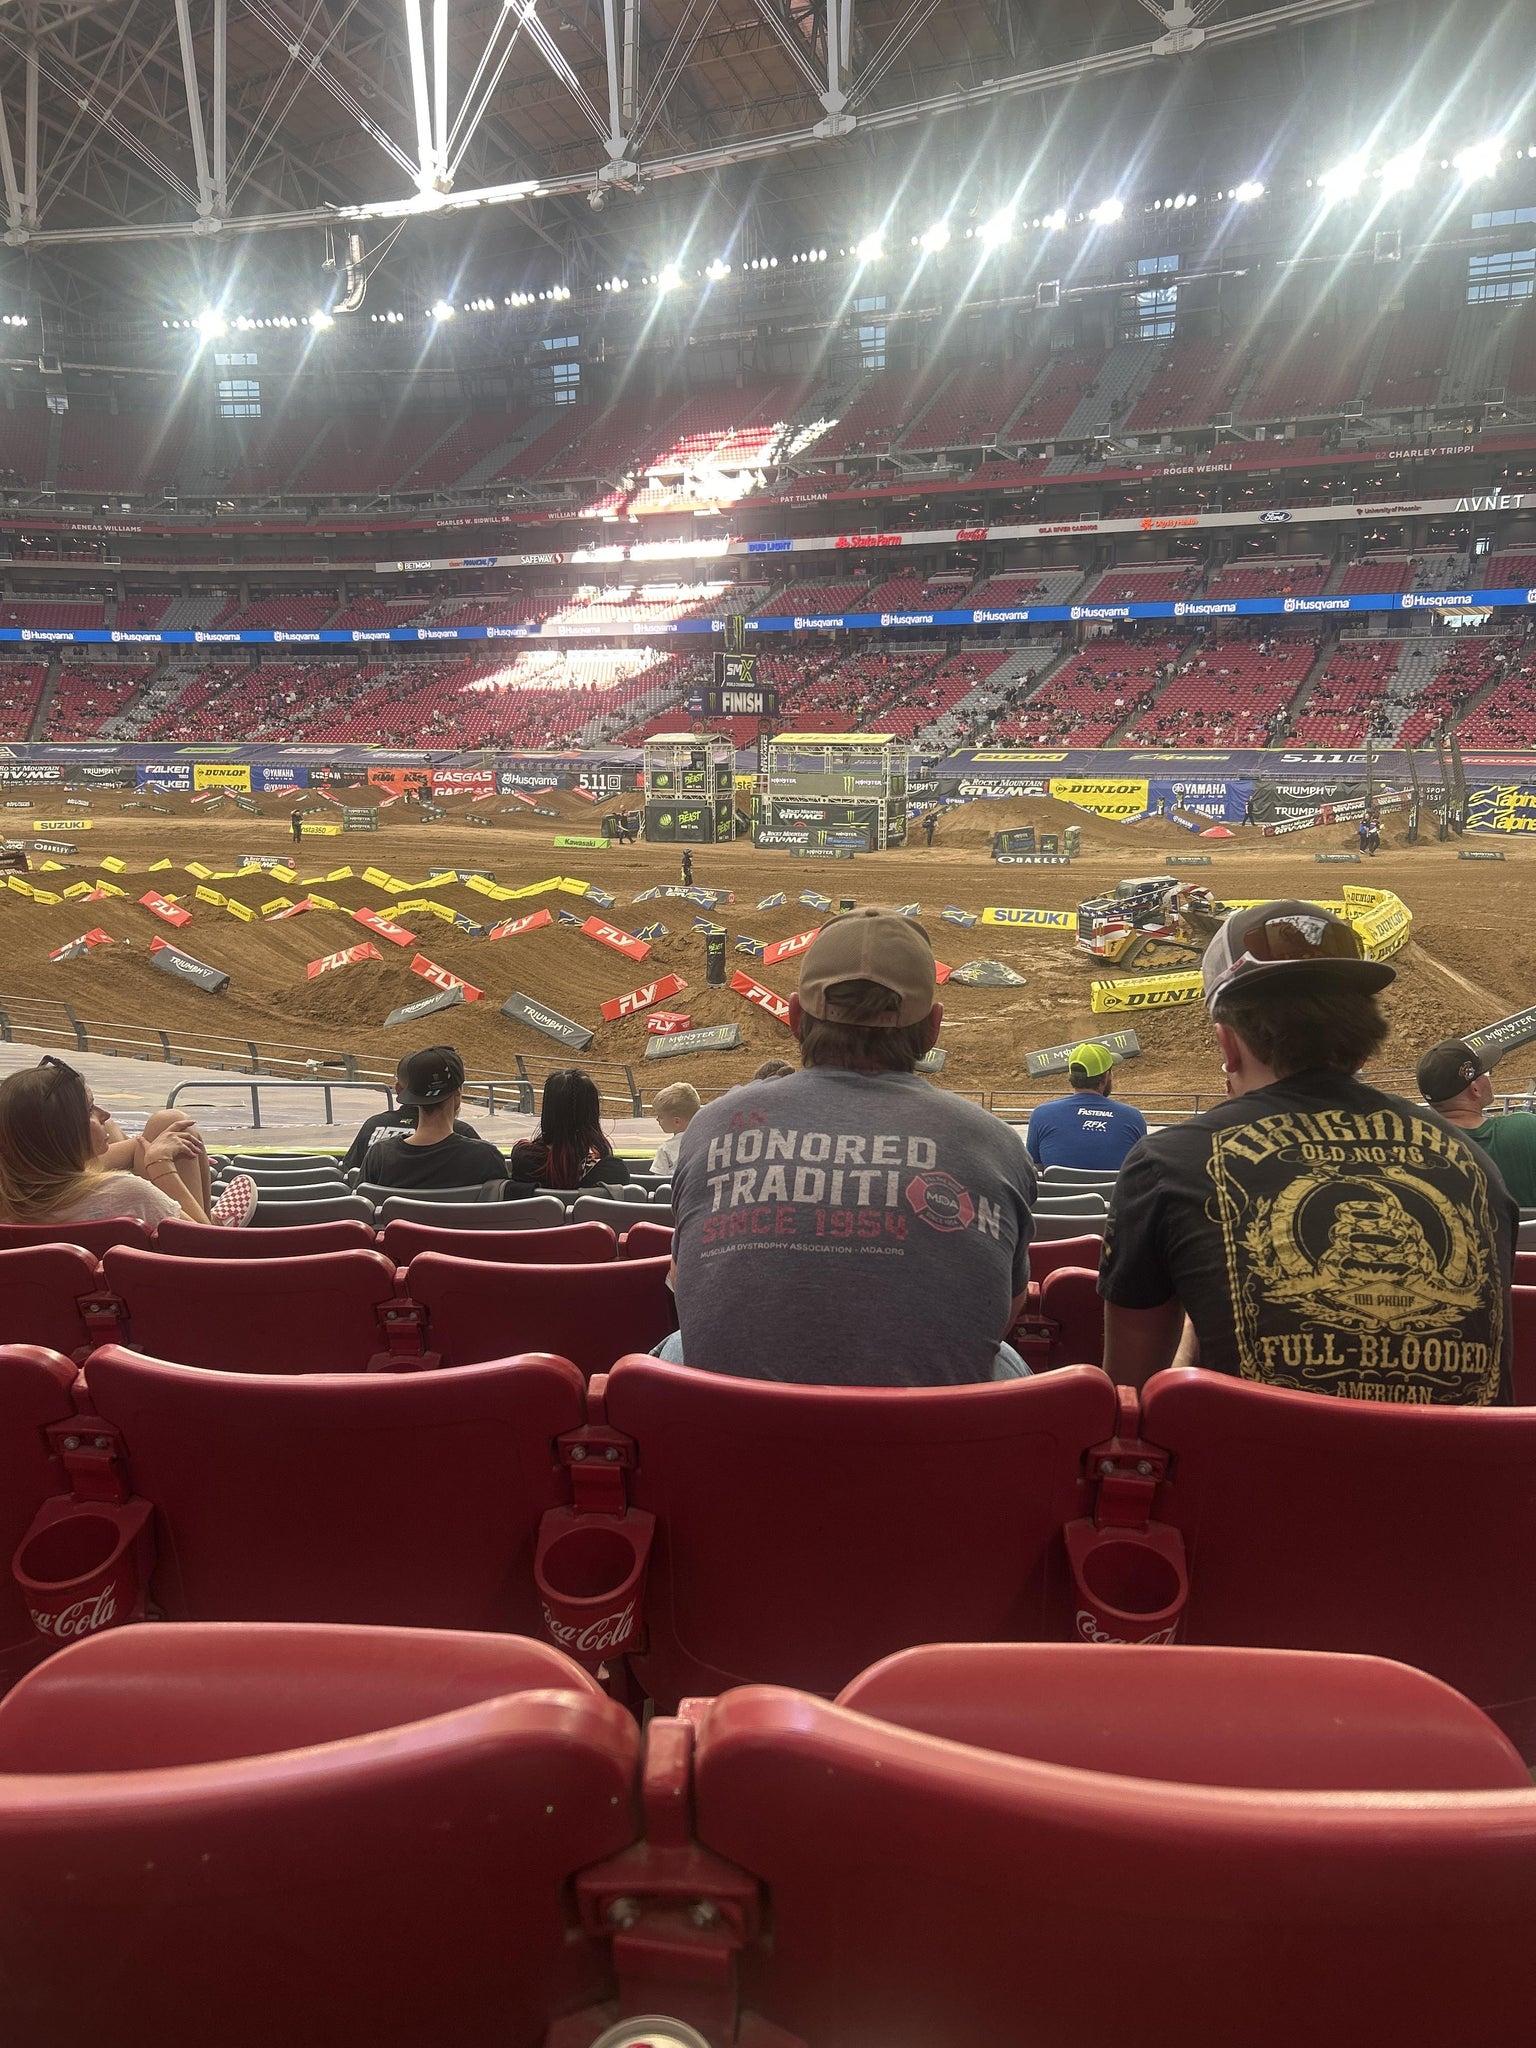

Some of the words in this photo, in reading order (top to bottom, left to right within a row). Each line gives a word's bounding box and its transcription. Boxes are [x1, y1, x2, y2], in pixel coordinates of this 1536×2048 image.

[1388, 448, 1438, 459] CHARLEY
[1440, 445, 1474, 456] TRIPPI
[1163, 467, 1194, 476] ROGER
[1196, 463, 1232, 474] WEHRLI
[780, 496, 794, 504] PAT
[796, 493, 828, 503] TILLMAN
[1455, 494, 1524, 512] AVNET
[437, 518, 462, 527] CHARLES
[1264, 511, 1287, 522] Ford
[71, 523, 102, 532] AENEAS
[104, 525, 142, 533] WILLIAMS
[956, 528, 989, 541] Coca-Cola
[749, 543, 764, 553] BUD
[766, 540, 792, 551] LIGHT
[404, 561, 431, 570] BETMGM
[520, 554, 553, 565] SAFEWAY
[1295, 597, 1350, 611] Husqvarna
[1414, 593, 1472, 607] Husqvarna
[1081, 607, 1129, 619] Husqvarna
[1185, 601, 1236, 615] Husqvarna
[890, 614, 933, 625] Husqvarna
[983, 610, 1029, 622] Husqvarna
[803, 617, 844, 628] Husqvarna
[31, 631, 74, 641] Husqvarna
[120, 632, 162, 642] Husqvarna
[203, 632, 241, 642] Husqvarna
[282, 631, 320, 641] Husqvarna
[359, 631, 391, 641] Husqvarna
[425, 630, 458, 639] Husqvarna
[494, 627, 527, 637] Husqvarna
[722, 692, 763, 713] FINISH
[976, 753, 1066, 761] SUZUKI
[1280, 753, 1343, 763] 5.11
[22, 765, 59, 773] MOUNTAIN
[83, 767, 113, 776] TRIUMPH
[145, 765, 190, 775] FALKEN
[205, 769, 246, 778] DUNLOP
[270, 768, 294, 778] YAMAHA
[372, 772, 395, 782] KTM
[433, 770, 493, 782] GASGAS
[511, 774, 558, 786] Husqvarna
[579, 774, 607, 789] 5.11
[972, 778, 999, 786] ROCKY
[1000, 779, 1043, 787] MOUNTAIN
[1070, 784, 1142, 794] DUNLOP
[1184, 783, 1226, 795] YAMAHA
[1275, 786, 1325, 797] TRIUMPH
[678, 810, 702, 825] BEAST
[40, 822, 85, 830] SUZUKI
[564, 839, 596, 847] Kawasaki
[1351, 893, 1376, 904] DUNLOP
[150, 899, 180, 918] FLY
[993, 909, 1069, 926] SUZUKI
[1376, 910, 1404, 937] DUNLOP
[367, 916, 403, 935] FLY
[502, 917, 533, 936] FLY
[596, 926, 635, 948] FLY
[777, 932, 813, 955] FLY
[170, 955, 205, 976] TRIUMPH
[320, 949, 353, 974] FLY
[424, 963, 464, 989] FLY
[619, 985, 657, 1015] FLY
[746, 985, 790, 1016] FLY
[401, 997, 434, 1016] TRIUMPH
[523, 1005, 564, 1033] TRIUMPH
[648, 1019, 676, 1032] FLY
[1485, 1015, 1536, 1041] MONSTER
[668, 1031, 715, 1043] MONSTER
[1077, 1107, 1114, 1118] FASTENAL
[728, 1109, 768, 1129] AN
[1083, 1120, 1108, 1129] RFK
[1221, 1109, 1477, 1178] ORIGINAL
[706, 1128, 938, 1173] HONORED
[1301, 1143, 1346, 1163] OLD
[926, 1191, 960, 1210] MDA
[700, 1206, 798, 1244] SINCE
[815, 1207, 910, 1241] 1954
[700, 1244, 736, 1259] MUSCULAR
[737, 1243, 788, 1254] DYSTROPHY
[789, 1243, 853, 1254] ASSOCIATION
[859, 1245, 905, 1256] MDA.ORG
[1354, 1294, 1375, 1305] 100
[1377, 1294, 1416, 1308] PROOF
[1260, 1333, 1489, 1374] FULL-BLOODED
[1336, 1381, 1434, 1405] AMERICAN
